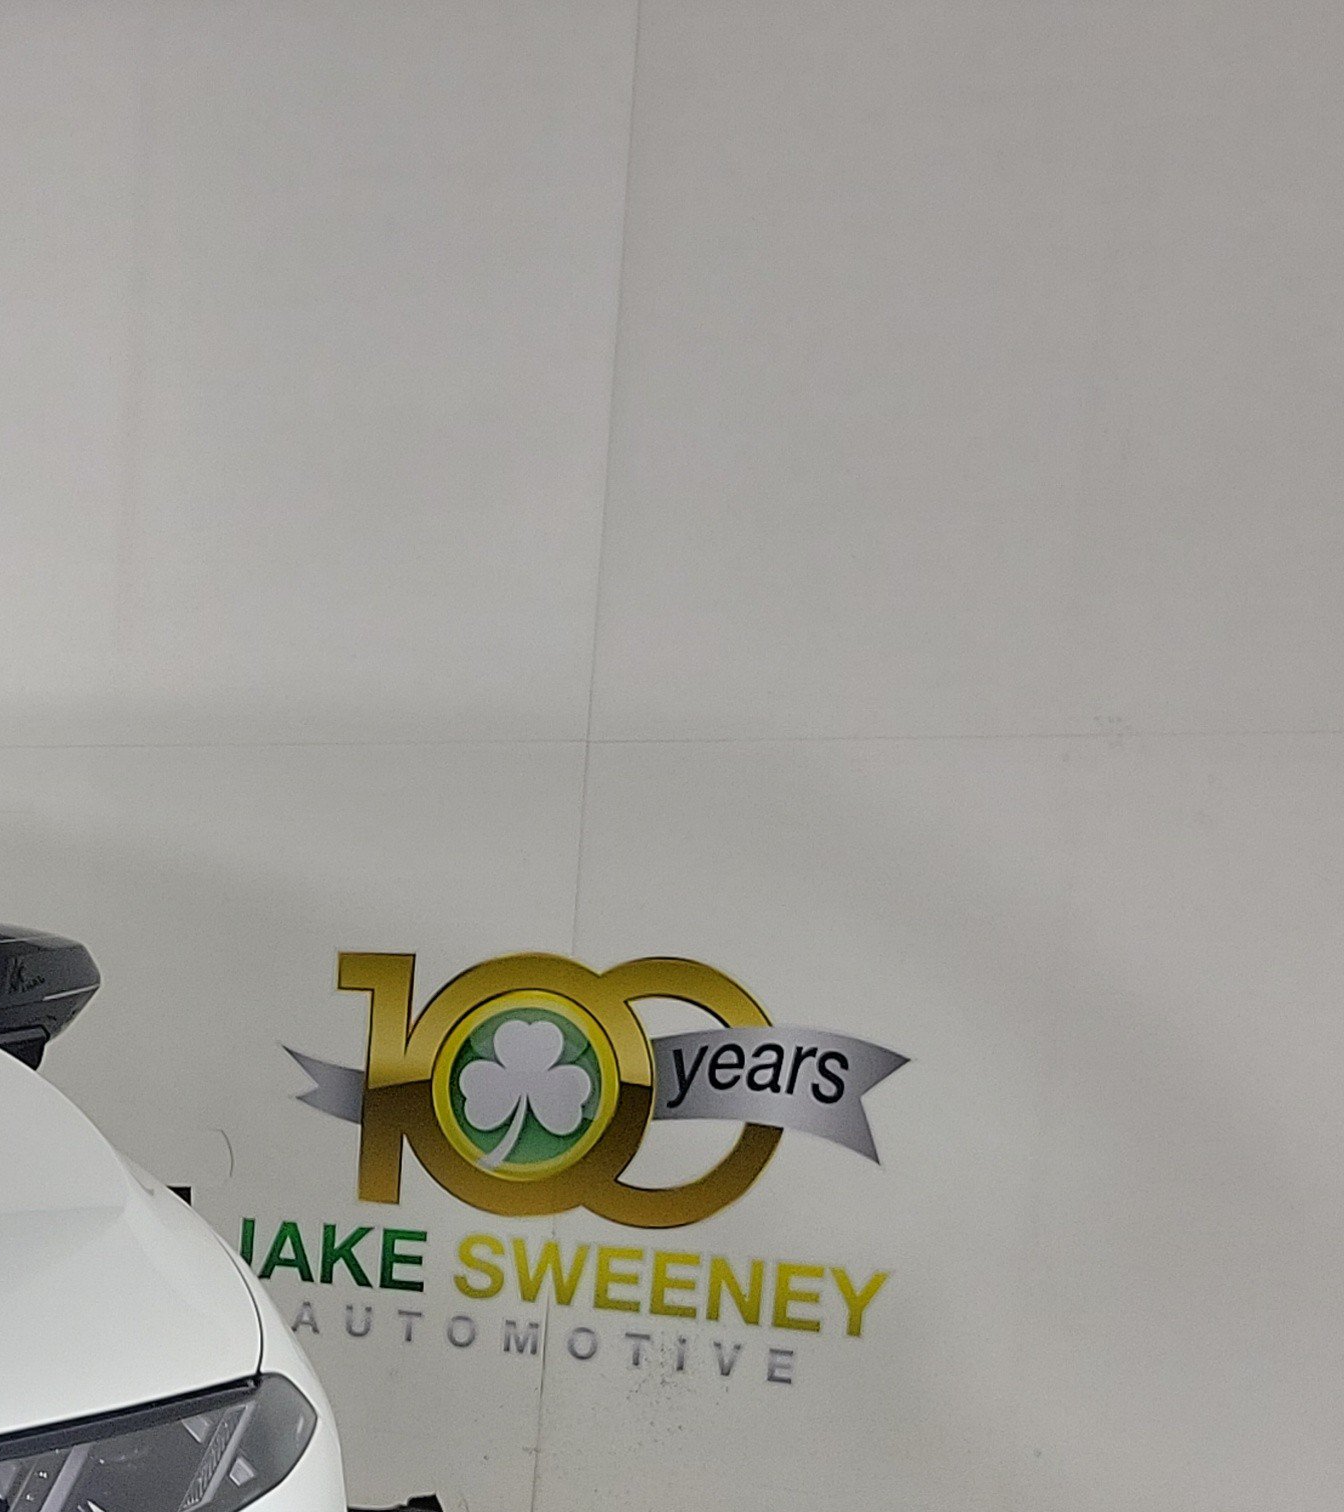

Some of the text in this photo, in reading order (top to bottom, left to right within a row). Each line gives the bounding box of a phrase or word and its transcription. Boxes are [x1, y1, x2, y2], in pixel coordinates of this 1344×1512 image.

[337, 951, 850, 1229] 100 years
[452, 1233, 889, 1339] SWEENEY
[290, 1300, 795, 1385] AUTOMOTIVE
